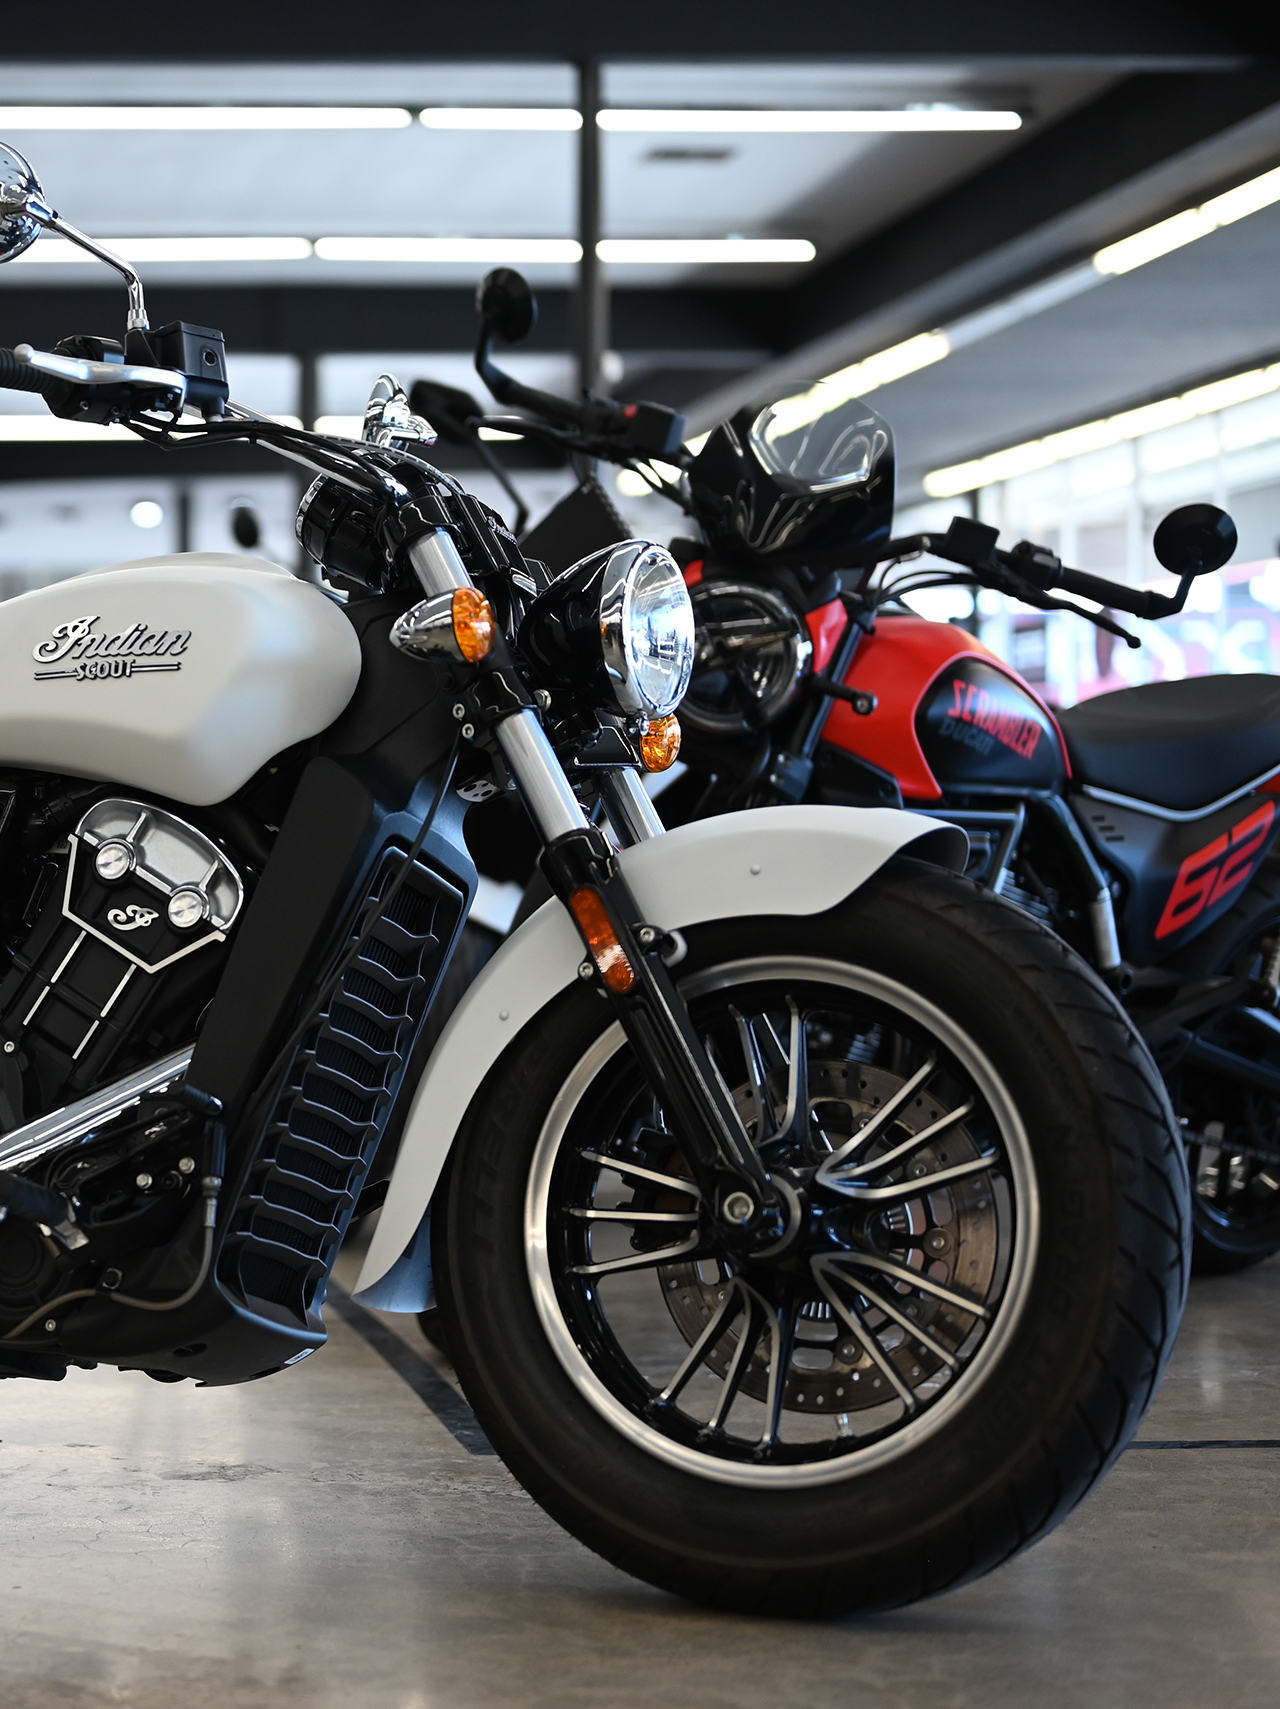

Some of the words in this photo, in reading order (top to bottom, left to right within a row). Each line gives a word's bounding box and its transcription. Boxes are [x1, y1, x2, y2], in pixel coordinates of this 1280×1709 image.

[32, 616, 191, 663] Indian
[75, 659, 136, 681] SCOUT
[1154, 800, 1276, 940] 62
